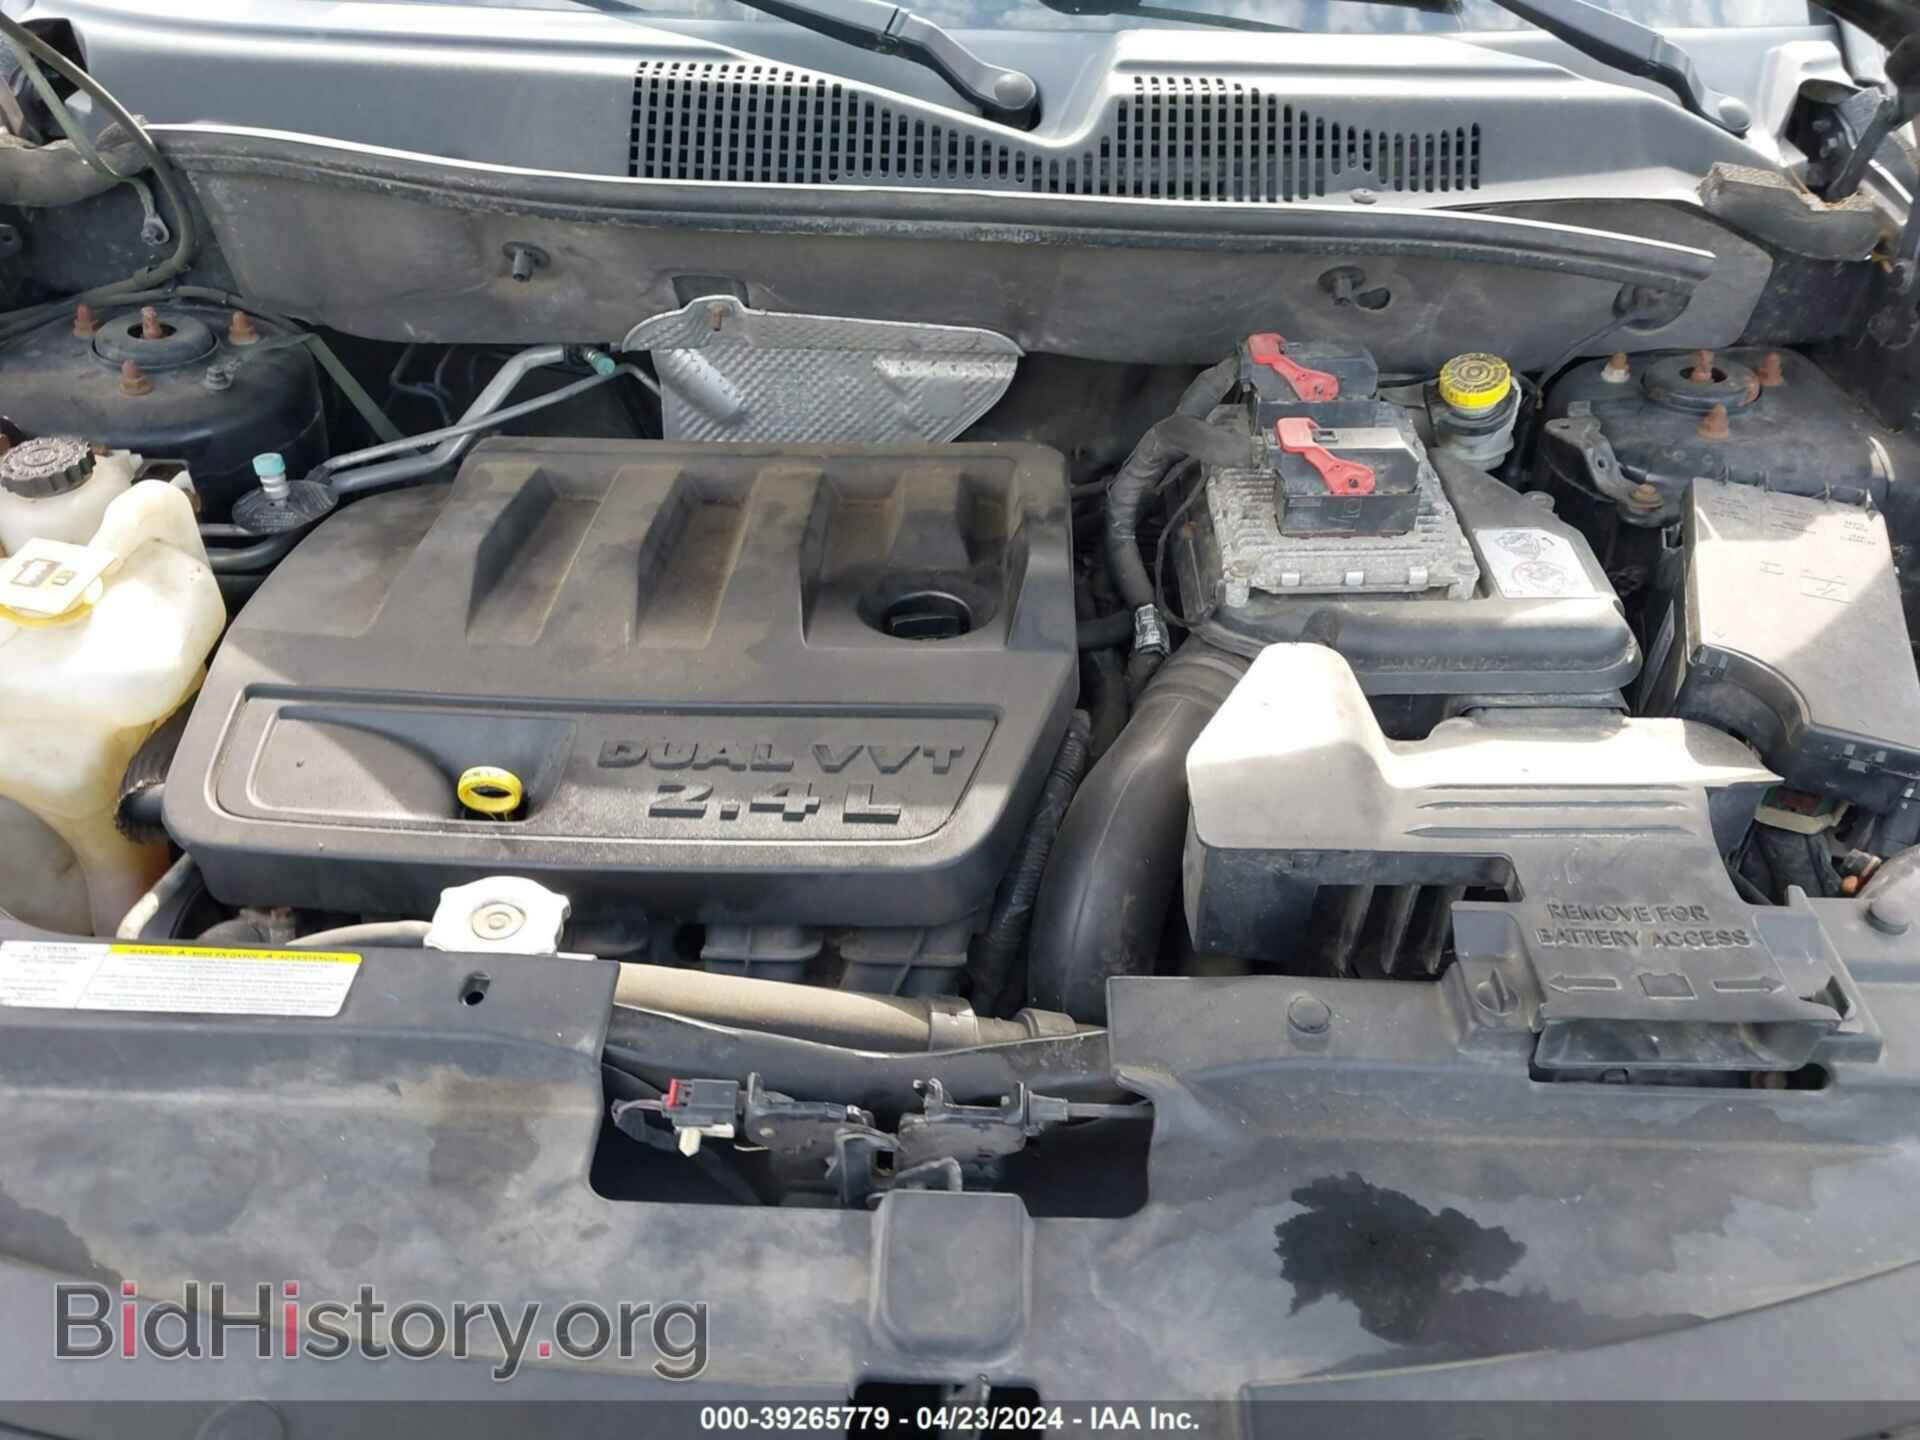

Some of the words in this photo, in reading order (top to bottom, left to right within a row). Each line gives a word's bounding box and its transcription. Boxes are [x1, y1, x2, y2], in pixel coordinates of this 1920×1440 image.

[597, 740, 795, 772] DUAL
[812, 742, 965, 775] VVT
[1547, 903, 1656, 923] REMOVE
[1657, 904, 1710, 922] FOR
[1536, 928, 1640, 948] BATTERY
[1653, 929, 1752, 950] ACCESS
